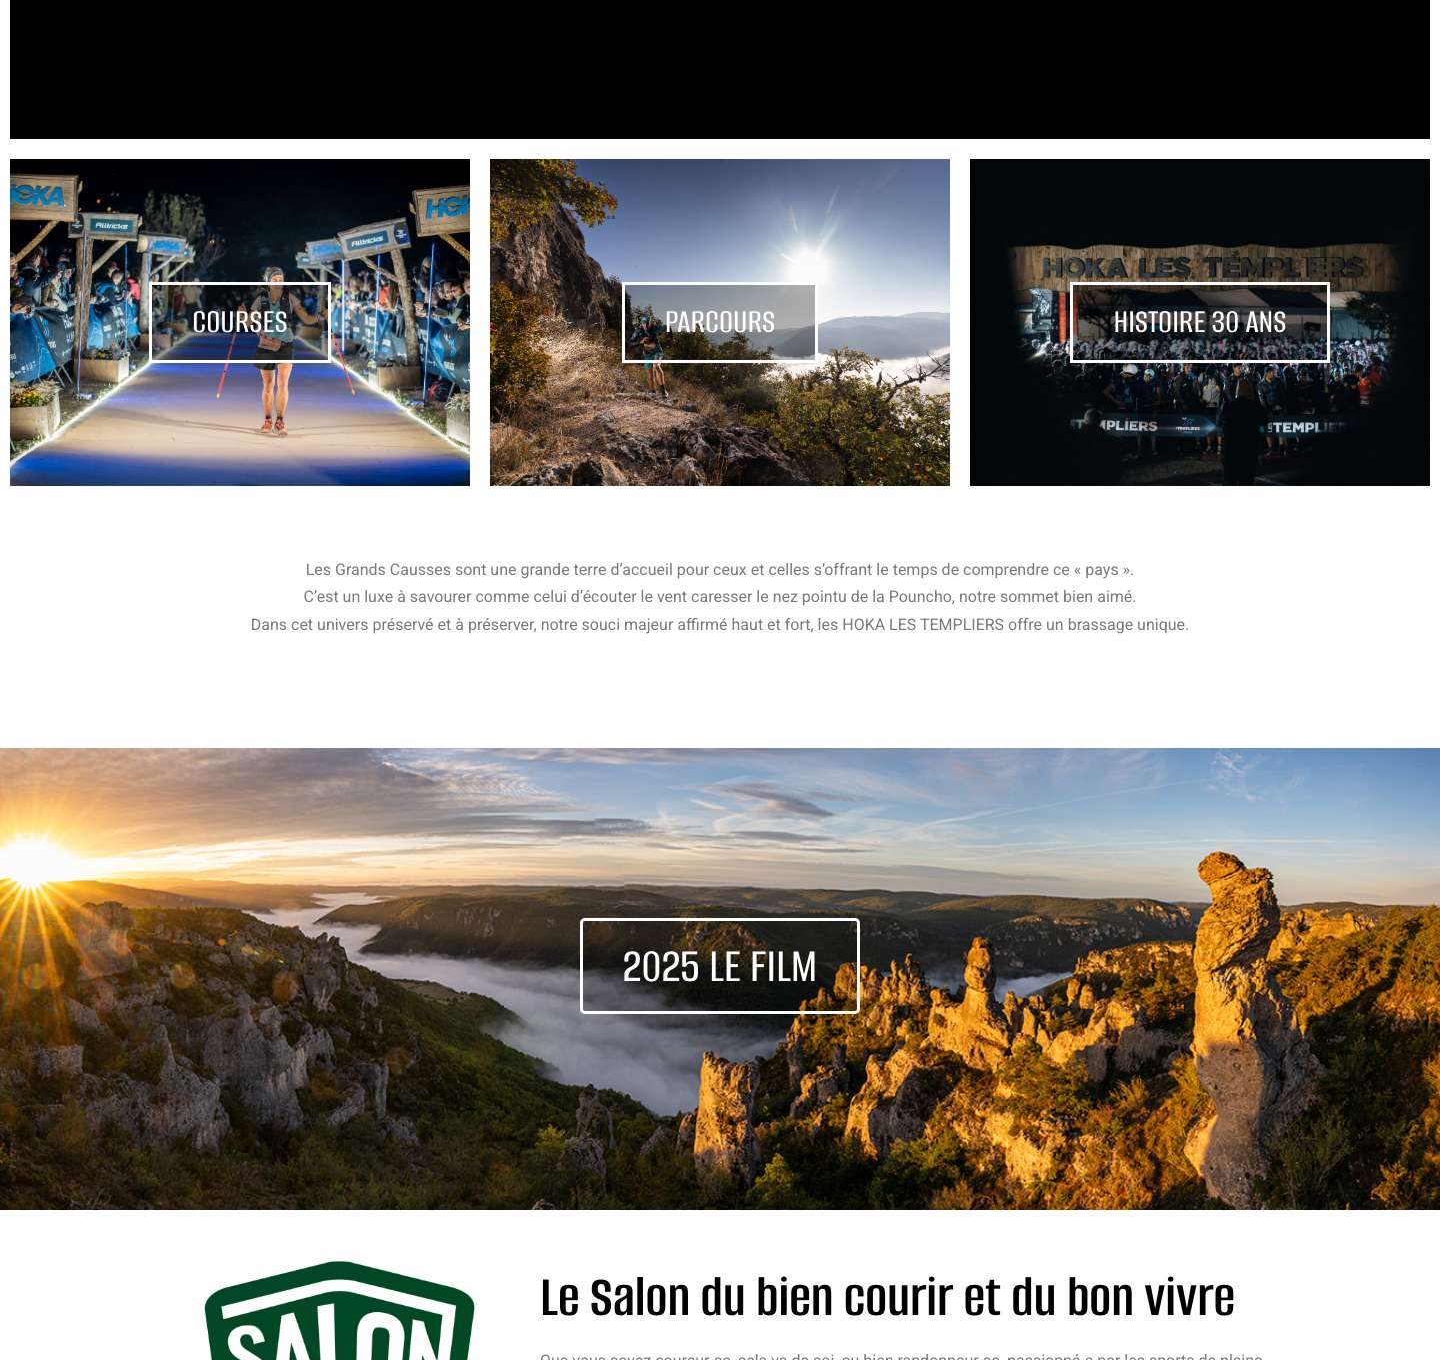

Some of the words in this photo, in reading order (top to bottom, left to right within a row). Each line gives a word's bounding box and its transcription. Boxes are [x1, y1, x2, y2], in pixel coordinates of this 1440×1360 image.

[1042, 256, 1129, 278] HOKA
[1139, 256, 1192, 278] LES
[193, 310, 287, 334] COURSES
[666, 310, 775, 334] PARCOURS
[1114, 310, 1205, 334] HISTOIRE
[1212, 310, 1239, 334] 30
[1245, 310, 1287, 334] ANS
[251, 617, 287, 631] Dans
[291, 618, 313, 631] cet
[317, 617, 369, 631] univers
[372, 617, 434, 634] préservé
[437, 618, 452, 631] et
[455, 617, 464, 631] à
[468, 617, 537, 634] préserver,
[541, 618, 578, 631] notre
[582, 618, 620, 631] souci
[624, 617, 674, 634] majeur
[677, 617, 728, 631] affirmé
[731, 617, 764, 631] haut
[767, 618, 781, 631] et
[784, 617, 814, 633] fort,
[818, 617, 838, 631] les
[842, 617, 886, 631] HOKA
[889, 617, 917, 631] LES
[919, 617, 1004, 631] TEMPLIERS
[1008, 617, 1042, 631] offre
[1046, 620, 1064, 631] un
[1068, 617, 1134, 634] brassage
[1137, 617, 1189, 634] unique.
[623, 950, 699, 982] 2025
[710, 950, 740, 982] LE
[752, 950, 816, 982] FILM
[542, 1278, 579, 1317] Le
[590, 1276, 689, 1317] Salon
[701, 1276, 744, 1317] du
[757, 1275, 833, 1317] bien
[844, 1275, 954, 1317] courir
[964, 1278, 1001, 1317] et
[1012, 1276, 1055, 1317] du
[1068, 1276, 1133, 1317] bon
[1144, 1275, 1235, 1317] vivre
